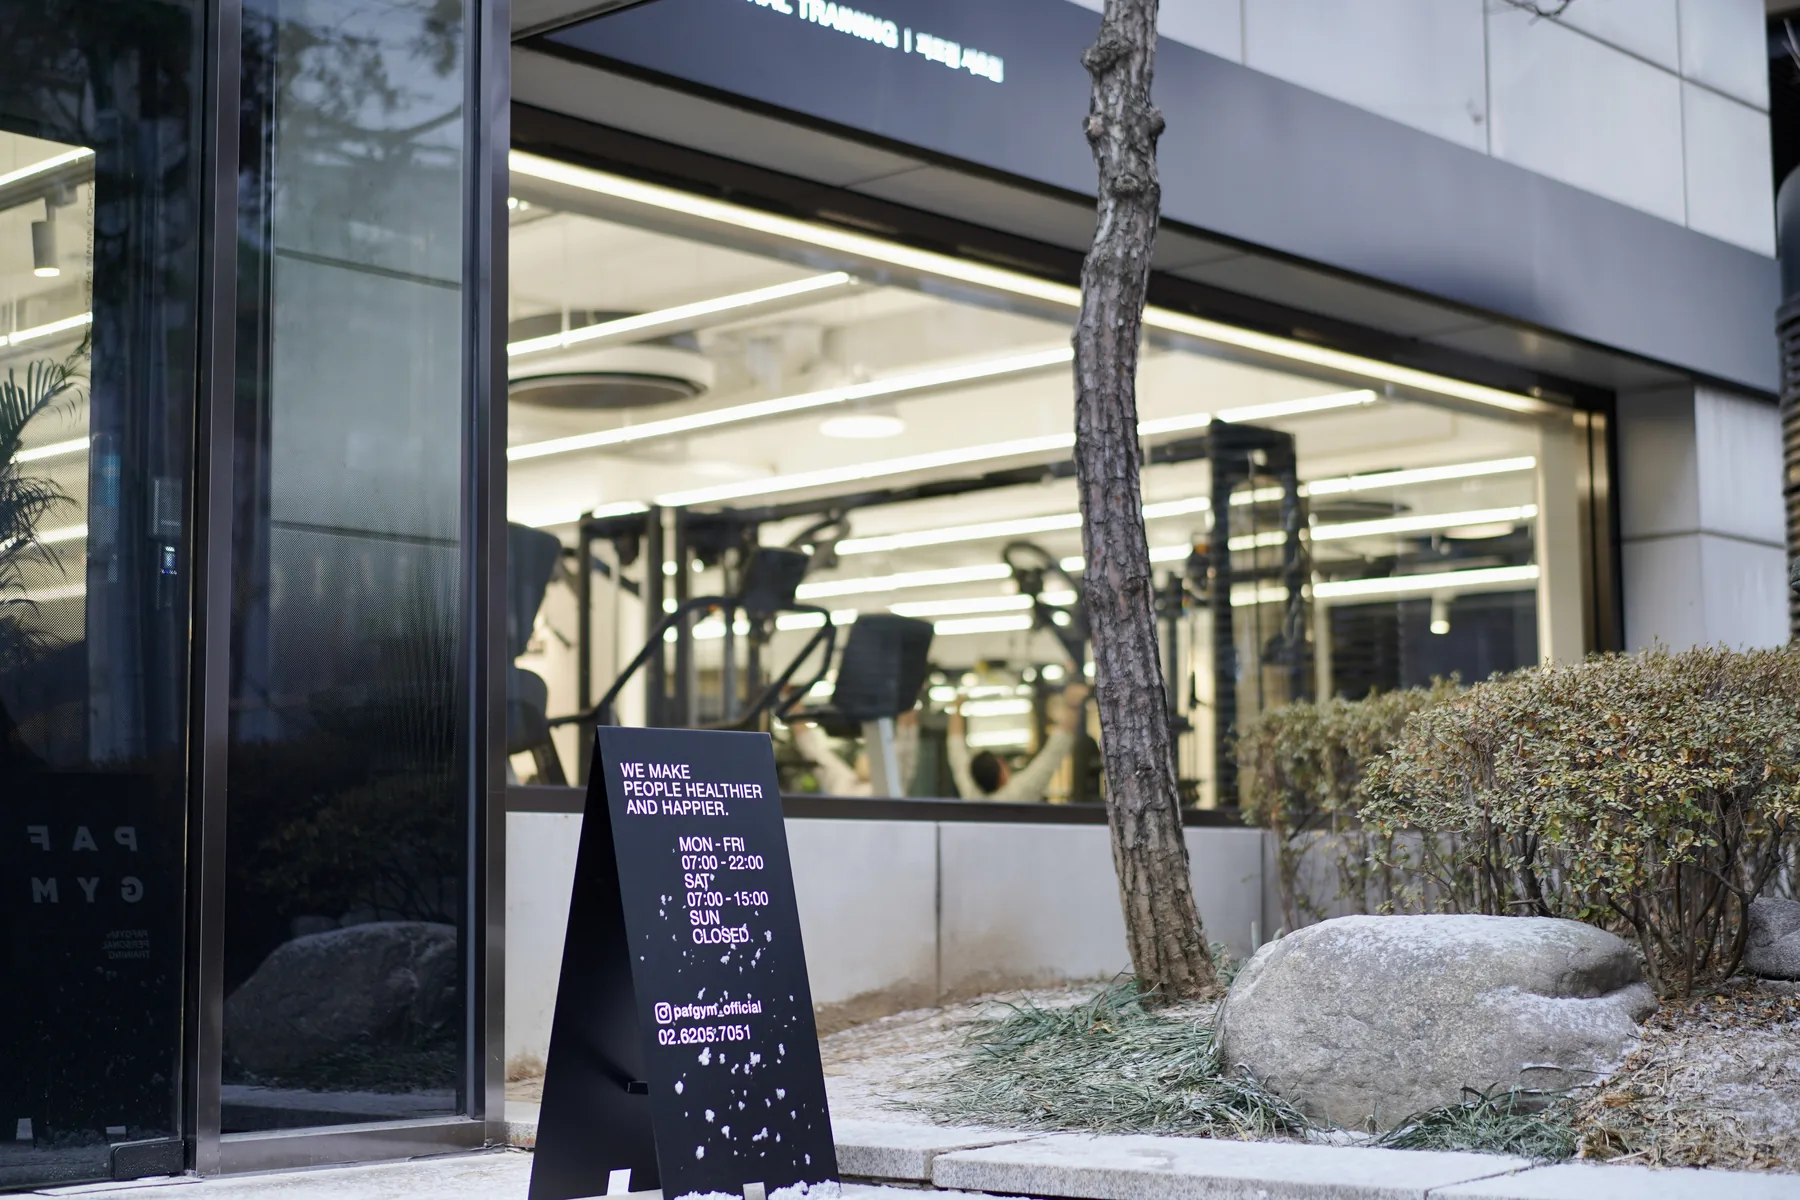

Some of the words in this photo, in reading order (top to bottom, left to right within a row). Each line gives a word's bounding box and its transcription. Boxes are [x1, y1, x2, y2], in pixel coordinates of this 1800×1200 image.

[620, 762, 645, 778] WE
[649, 764, 690, 779] MAKE
[624, 781, 682, 797] PEOPLE
[686, 783, 762, 798] HEALTHIER
[627, 800, 657, 815] AND
[663, 800, 729, 816] HAPPIER.
[679, 837, 713, 851] MON
[724, 837, 745, 851] FRI
[682, 855, 717, 870] 07:00
[729, 855, 763, 870] 22:00
[685, 873, 709, 888] SAT
[687, 892, 723, 906] 07:00
[734, 891, 768, 906] 15:00
[690, 910, 720, 925] SUN
[692, 928, 748, 944] CLOSED
[674, 1000, 762, 1020] pafgym_official
[658, 1024, 750, 1045] 02.6205.7051
